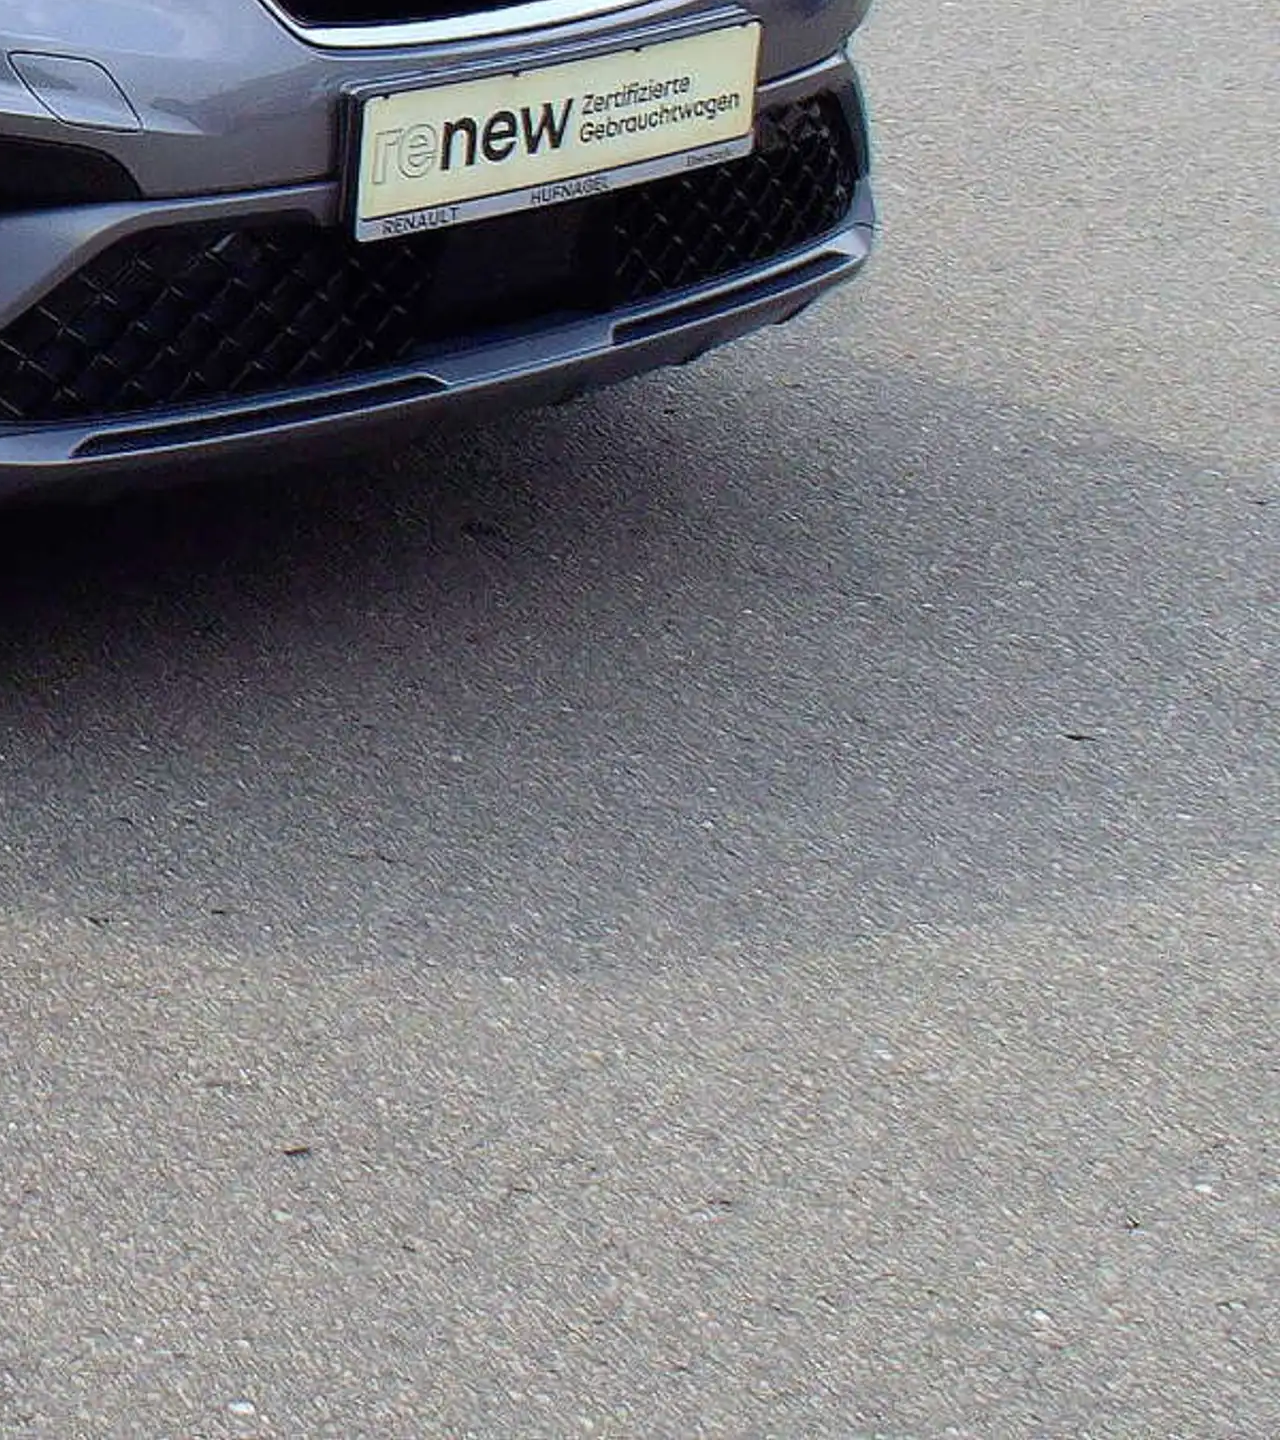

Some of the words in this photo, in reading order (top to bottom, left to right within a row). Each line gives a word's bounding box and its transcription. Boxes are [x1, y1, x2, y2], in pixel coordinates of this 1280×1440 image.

[579, 90, 741, 144] Gebrauchtwagen
[581, 73, 692, 115] Zertifizierte
[370, 97, 573, 185] renew
[381, 205, 460, 236] RENAULT
[531, 175, 612, 205] HUFNAGEL
